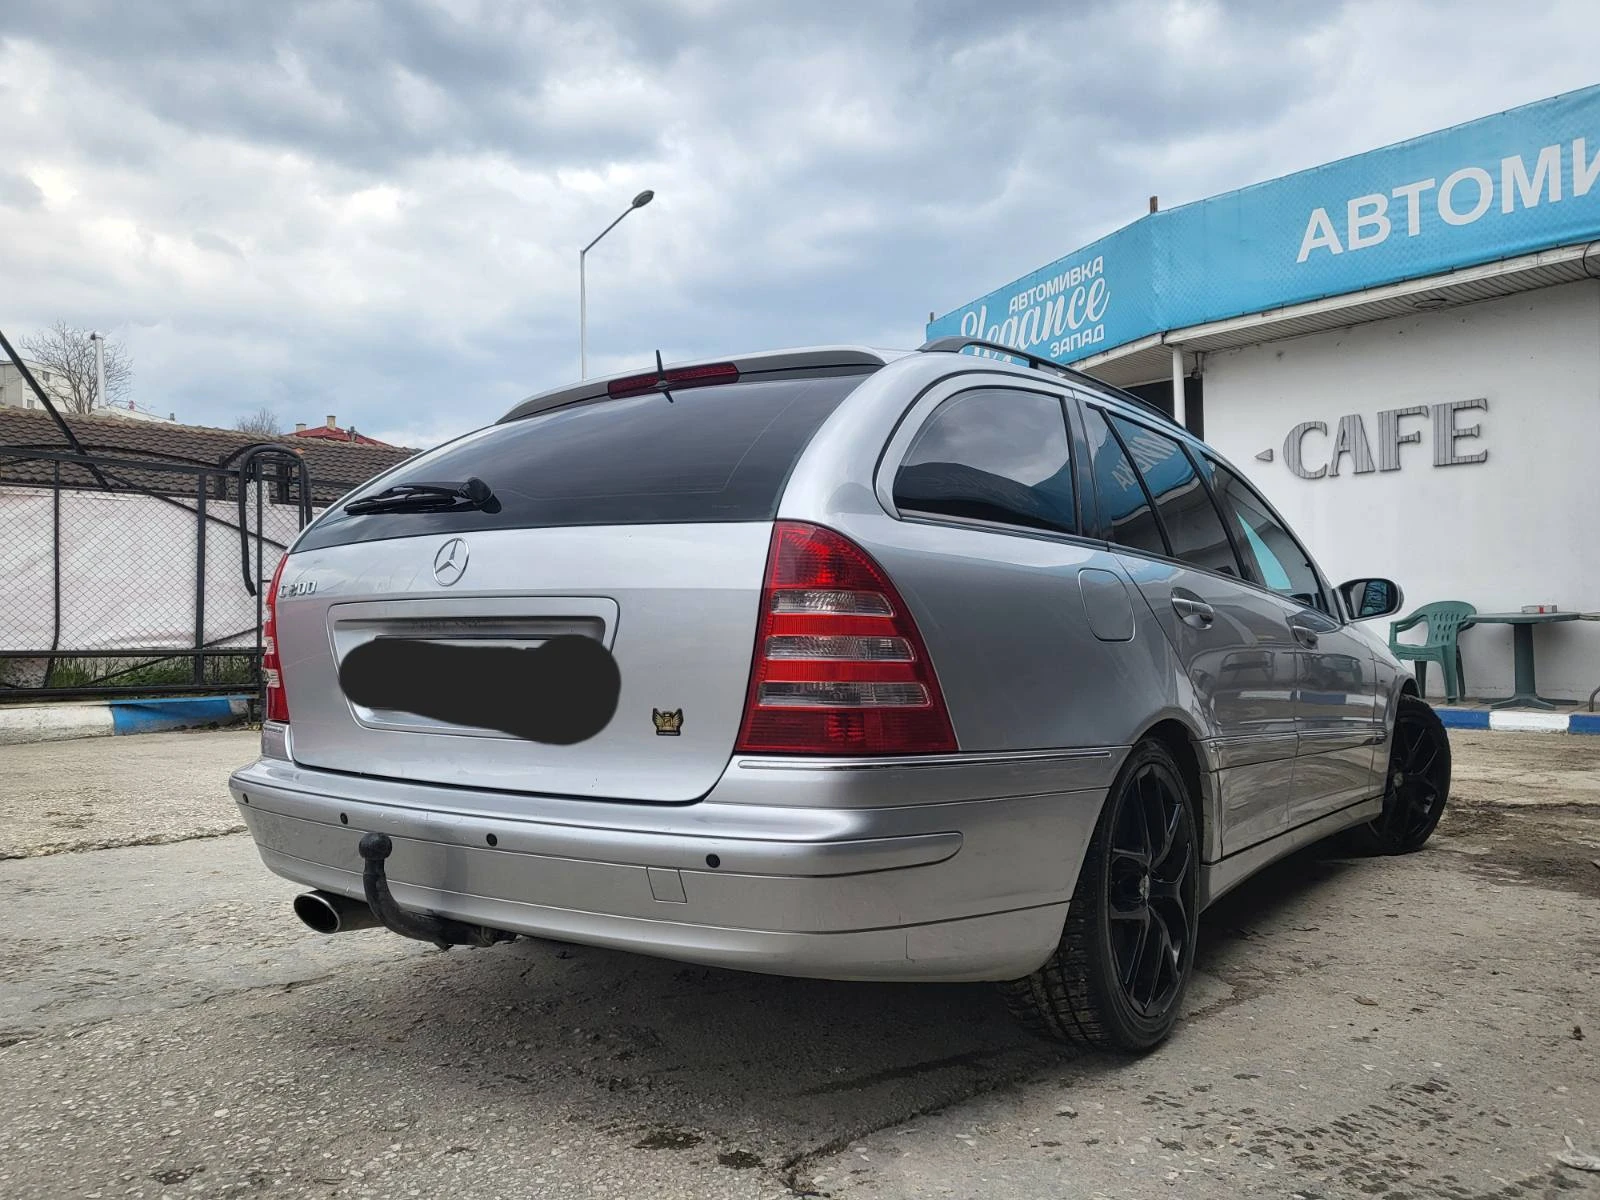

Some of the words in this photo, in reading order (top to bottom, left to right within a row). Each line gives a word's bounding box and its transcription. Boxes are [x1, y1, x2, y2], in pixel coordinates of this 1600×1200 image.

[1008, 255, 1104, 315] АВТОМИВКА
[1050, 323, 1105, 359] ЗАПАД
[1282, 398, 1488, 480] CAFE
[279, 584, 288, 598] C
[289, 580, 317, 597] 200
